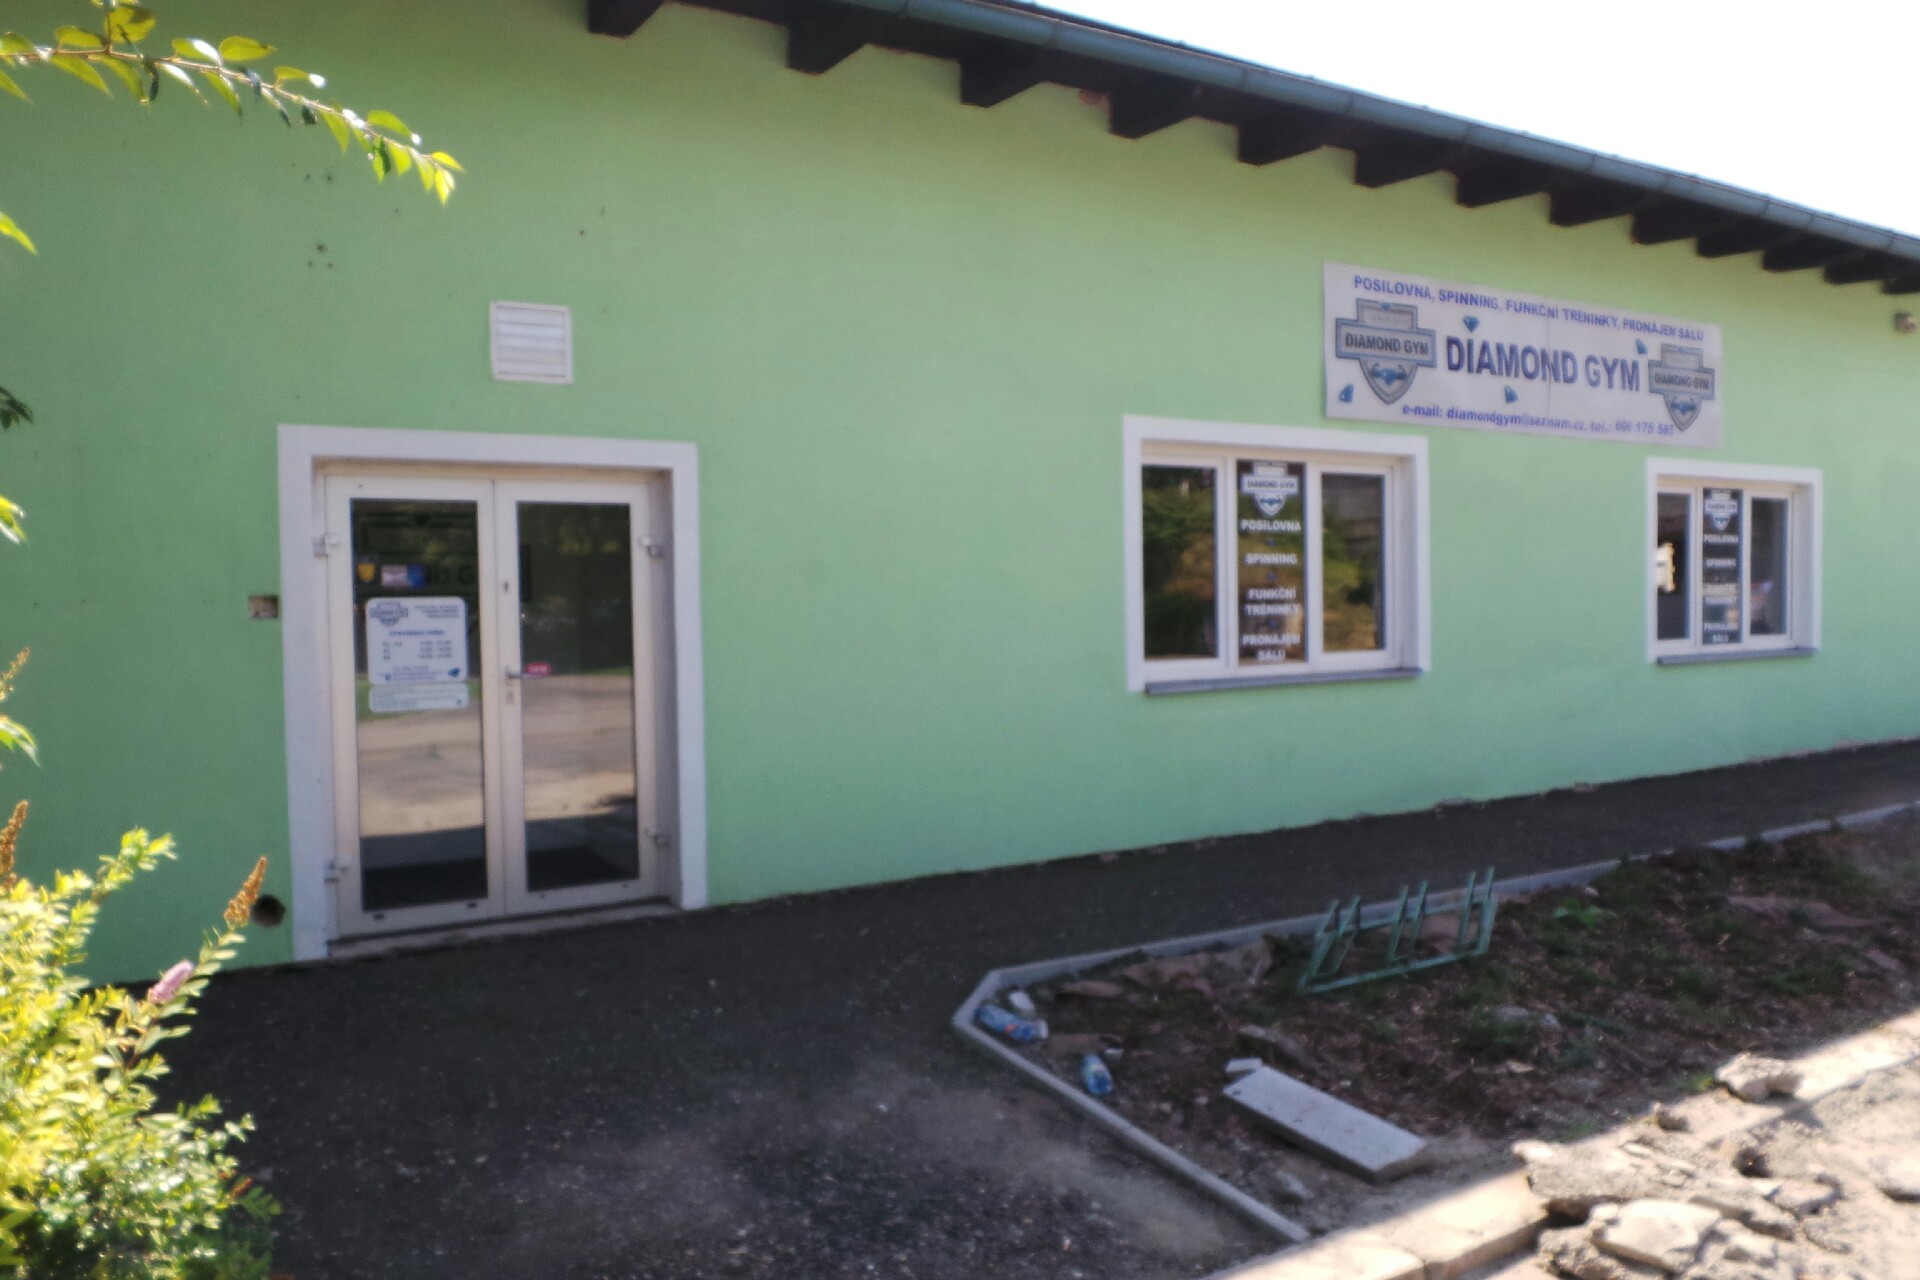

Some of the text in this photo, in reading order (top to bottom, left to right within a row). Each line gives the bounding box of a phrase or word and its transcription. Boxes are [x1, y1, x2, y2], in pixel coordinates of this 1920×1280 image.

[1354, 275, 1434, 300] POSILOVNA,
[1439, 289, 1502, 311] SPINNING,
[1346, 333, 1429, 356] DIAMOND GYM
[1447, 335, 1641, 392] DIAMOND GYM
[1402, 404, 1443, 418] e-mail:
[1242, 519, 1302, 532] POSILOVNA
[1245, 552, 1298, 565] SPINNING
